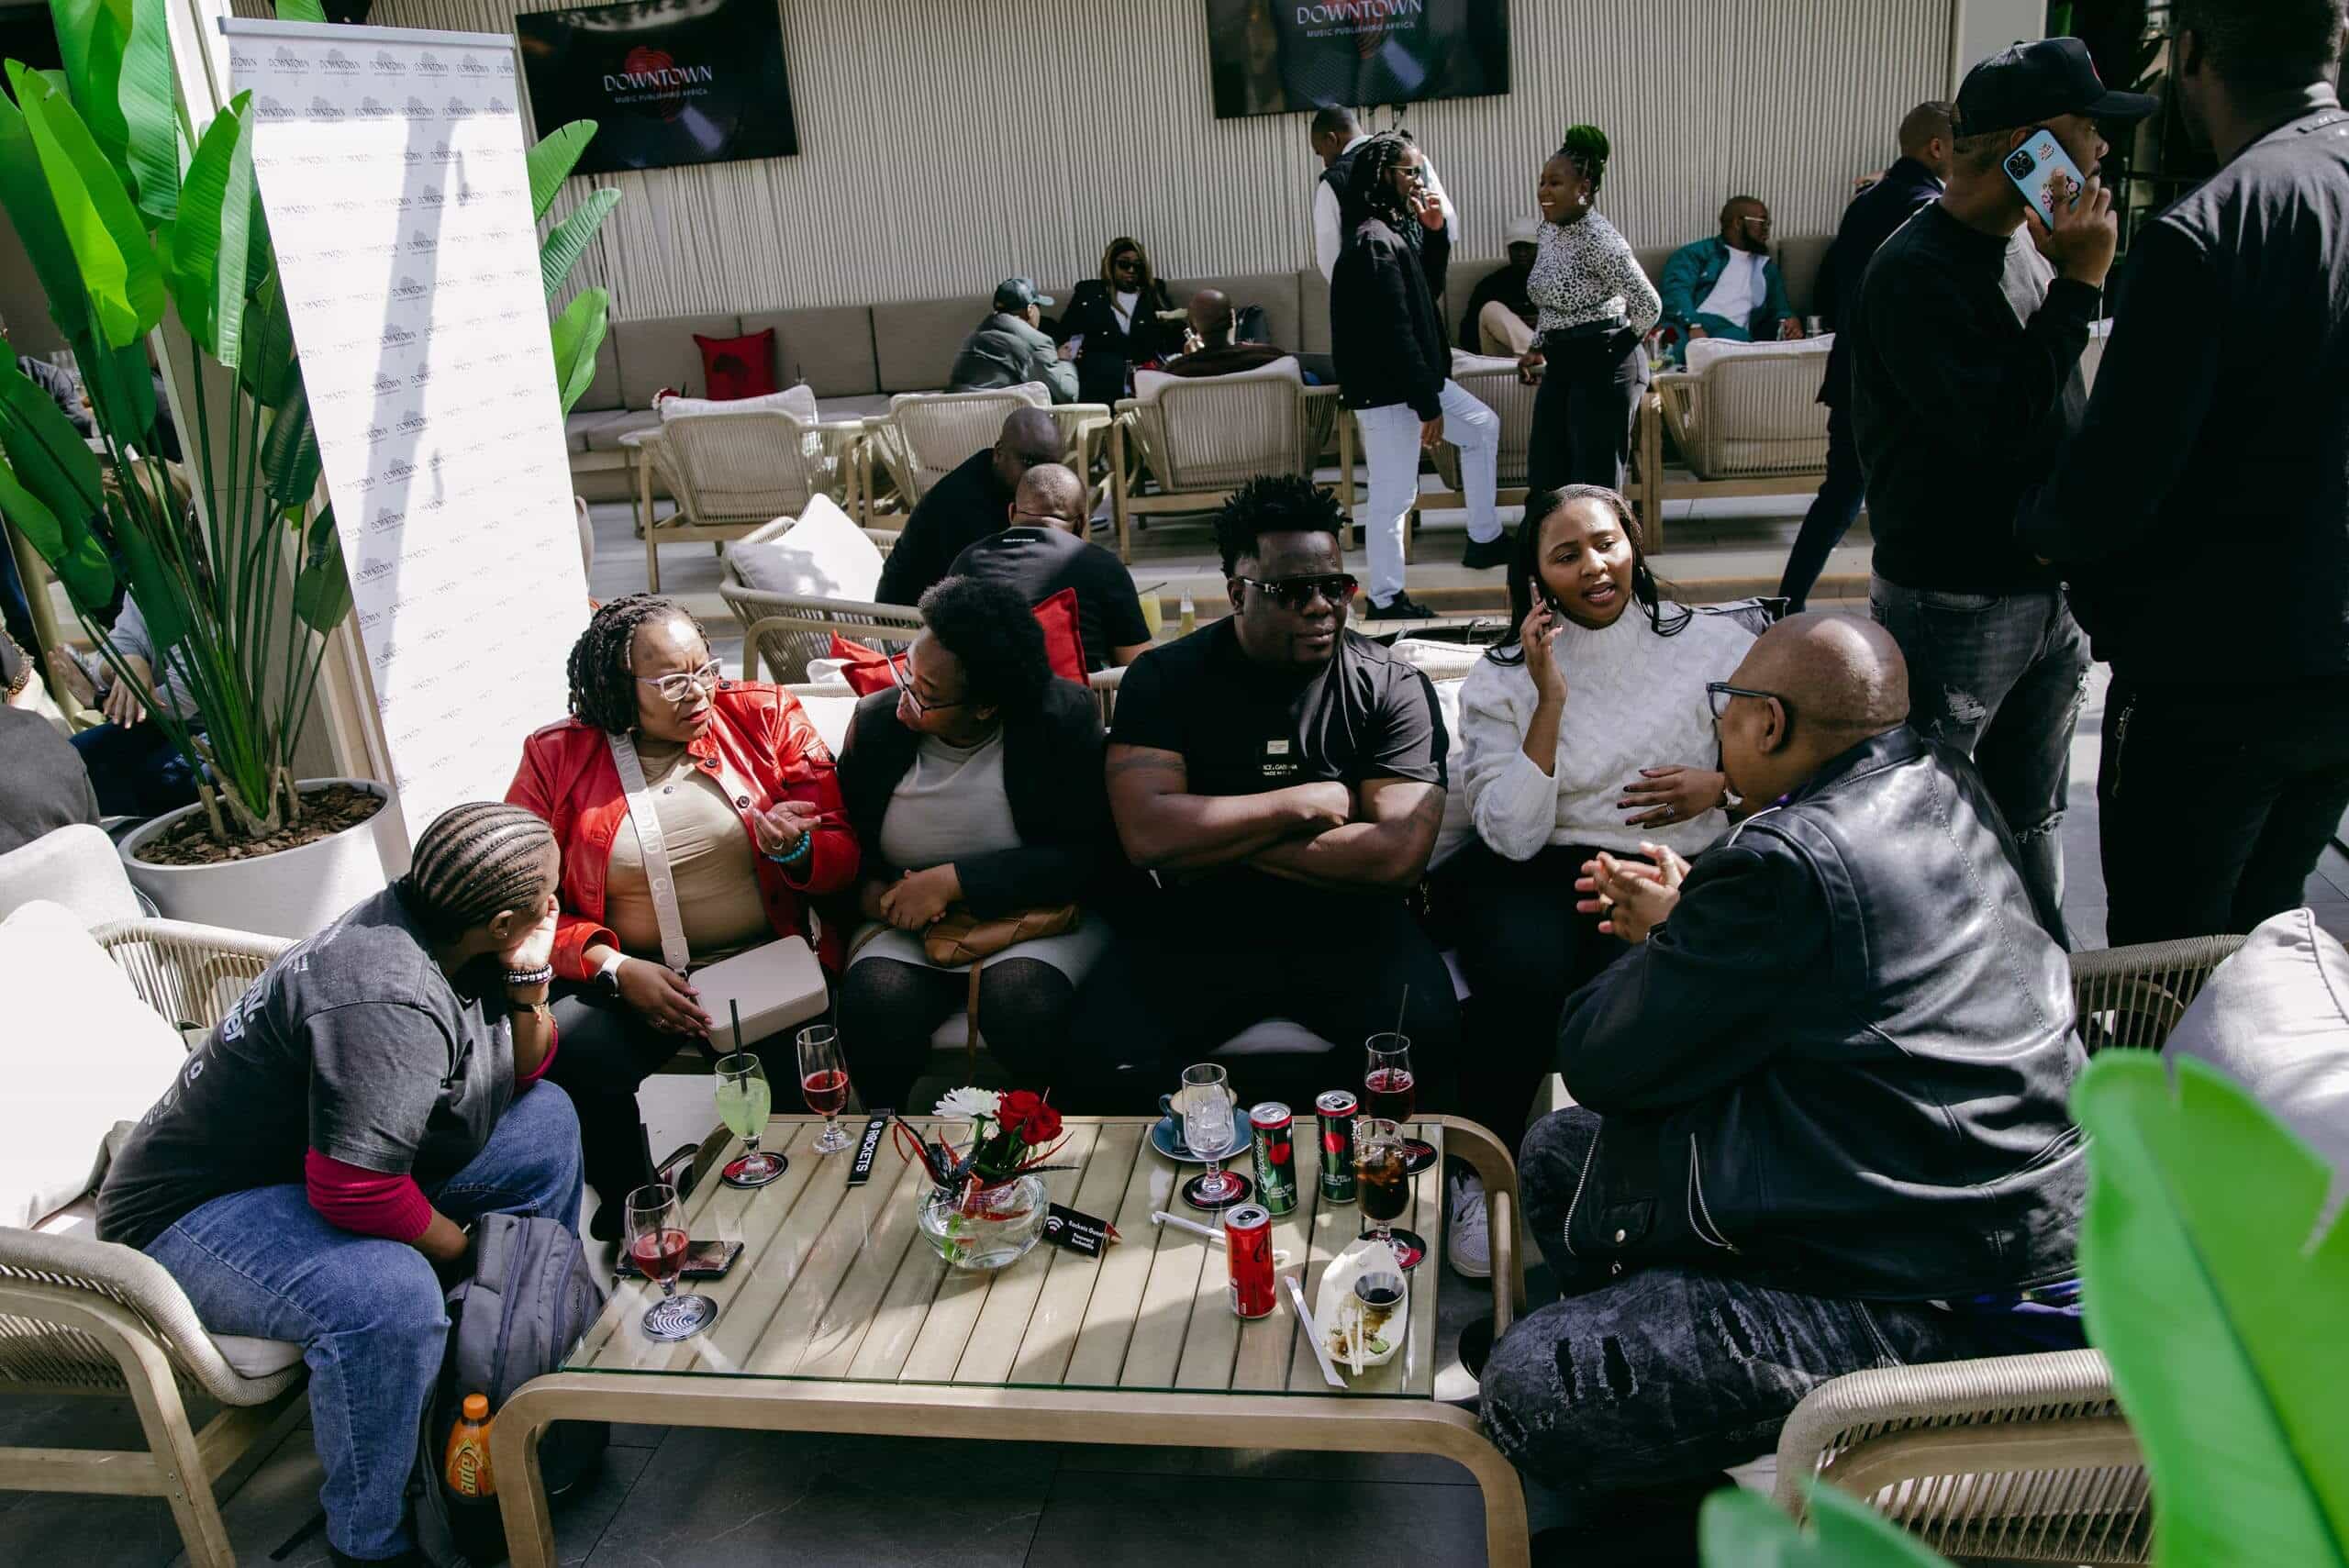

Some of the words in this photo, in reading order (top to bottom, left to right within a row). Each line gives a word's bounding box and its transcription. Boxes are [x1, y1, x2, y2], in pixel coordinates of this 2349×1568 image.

[1297, 0, 1422, 25] DOWNTOWN
[603, 65, 713, 92] DOWNTOWN
[855, 1129, 880, 1172] ROCKETS
